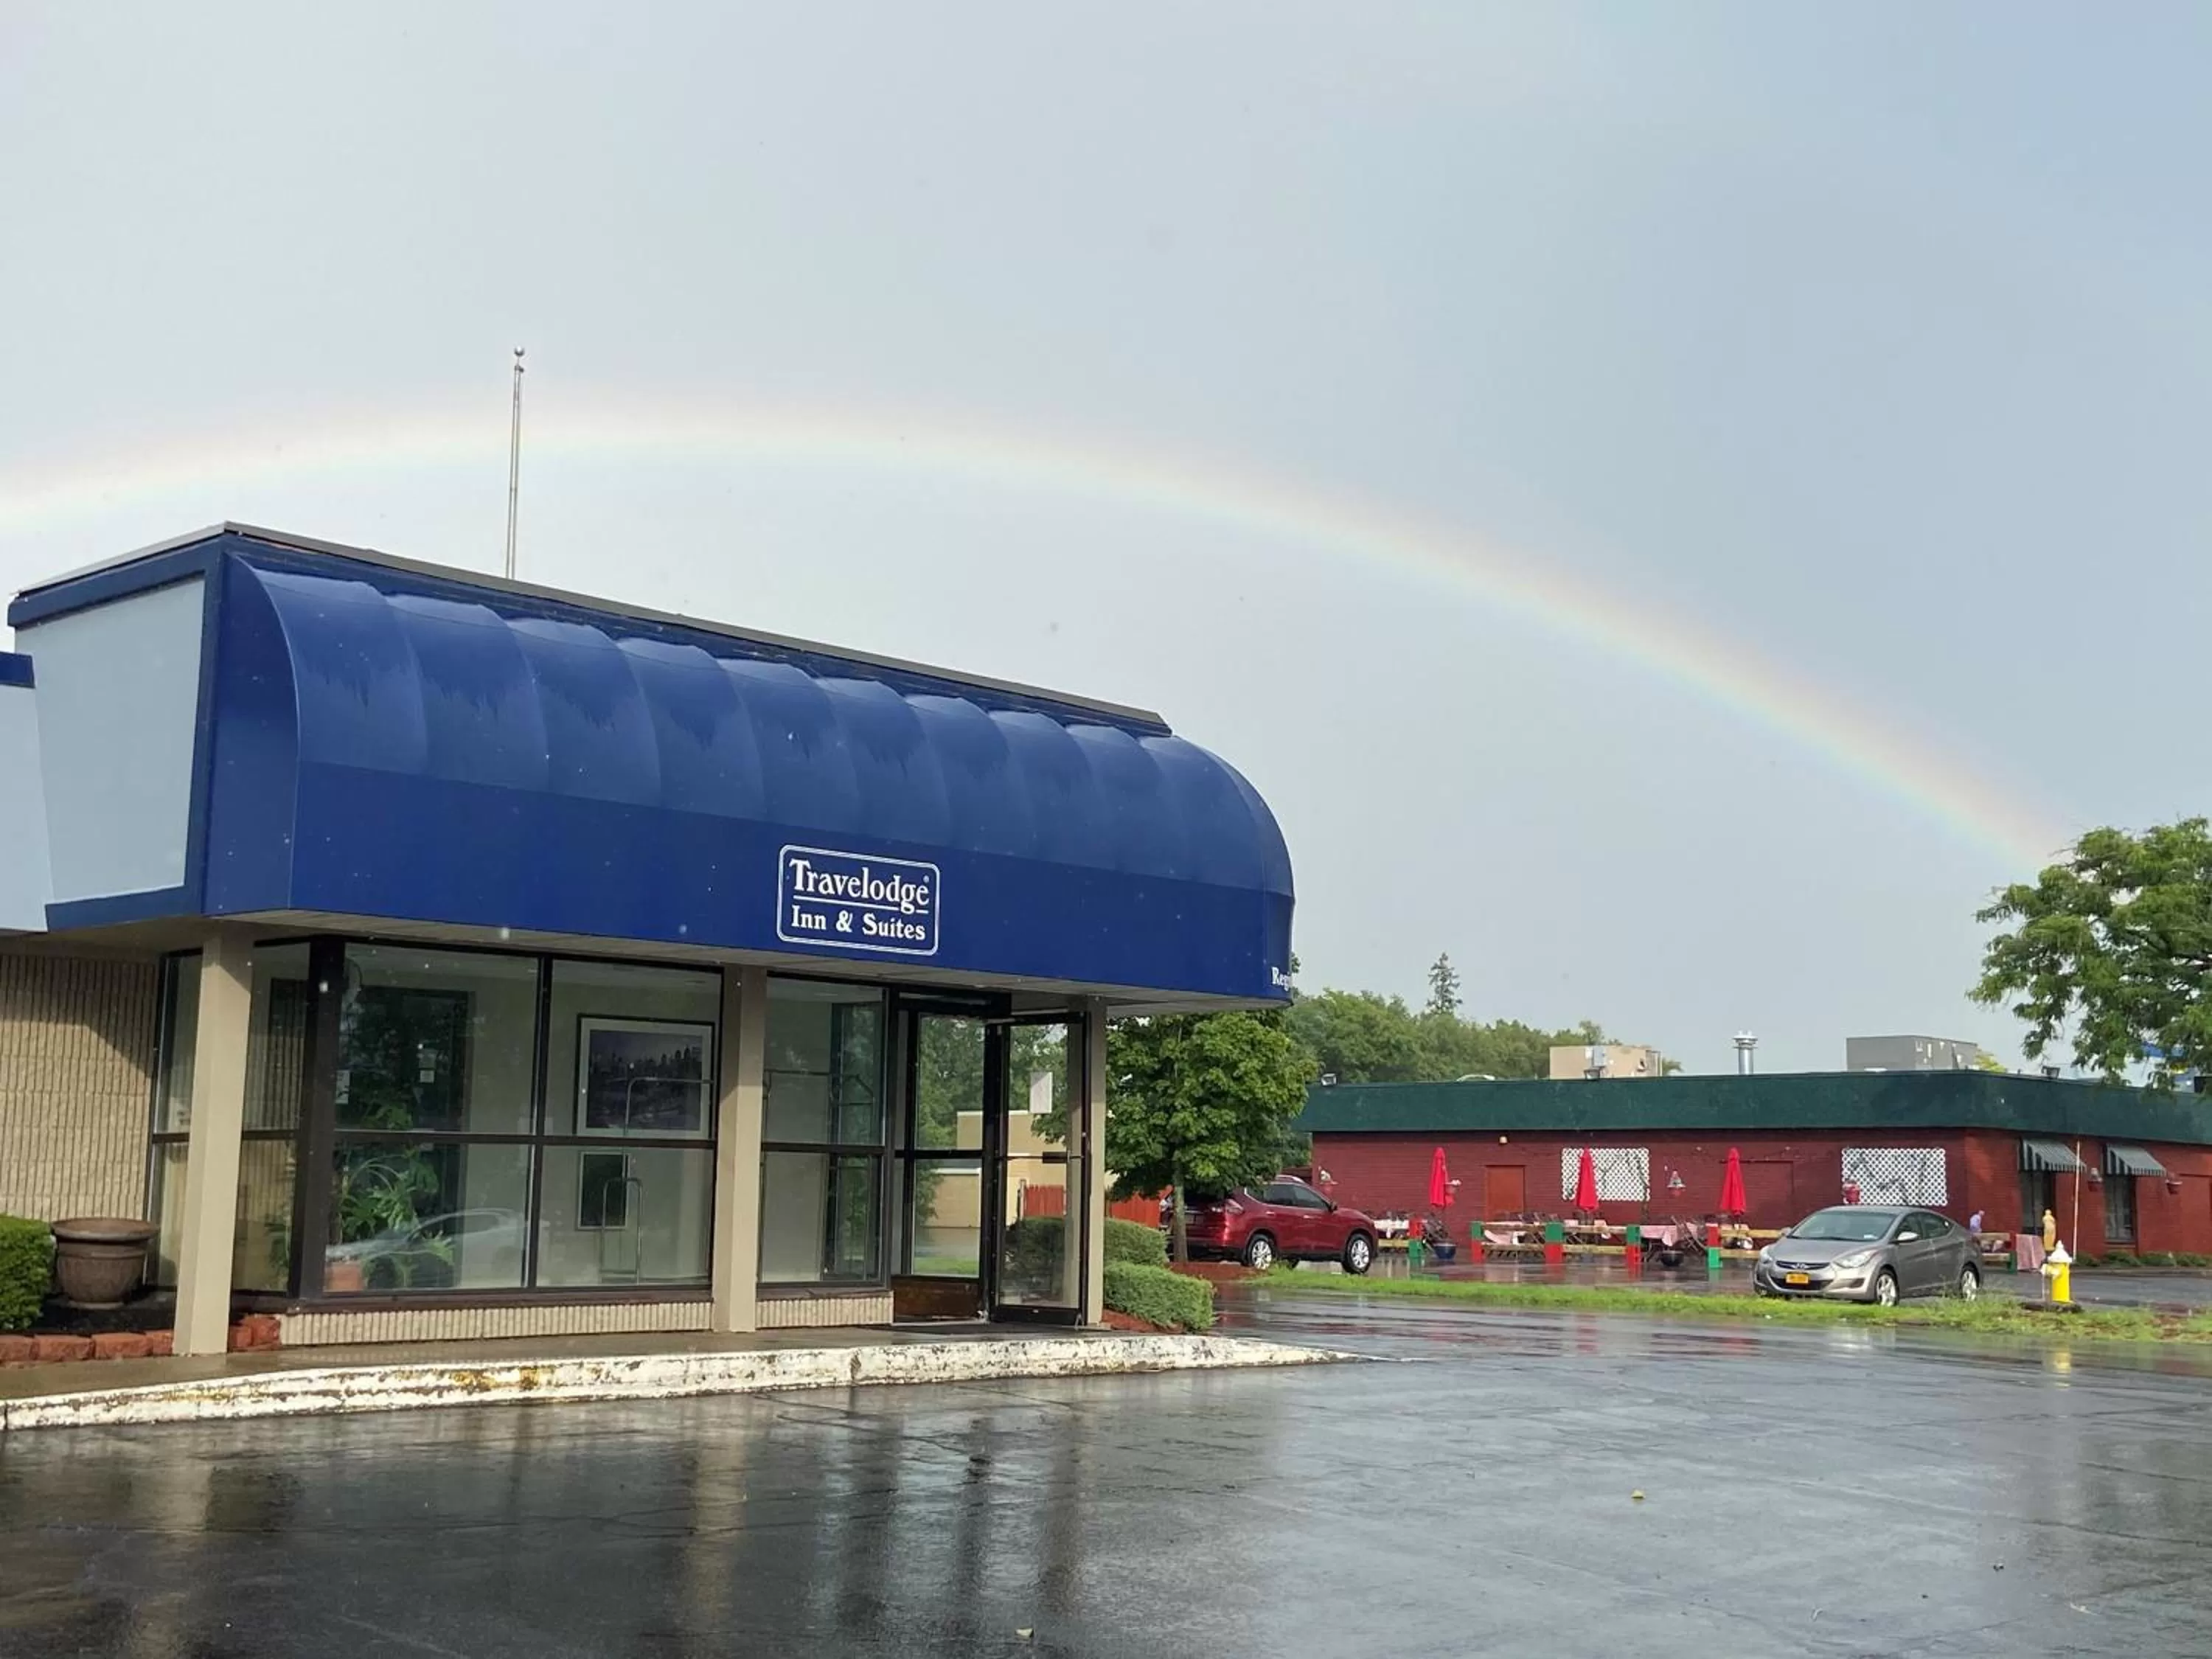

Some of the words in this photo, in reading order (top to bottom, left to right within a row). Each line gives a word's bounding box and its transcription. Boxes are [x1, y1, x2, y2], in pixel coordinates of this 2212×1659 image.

[789, 858, 929, 914] Travelodge
[791, 905, 827, 930] Inn
[835, 910, 853, 933] &
[863, 913, 926, 940] Suites
